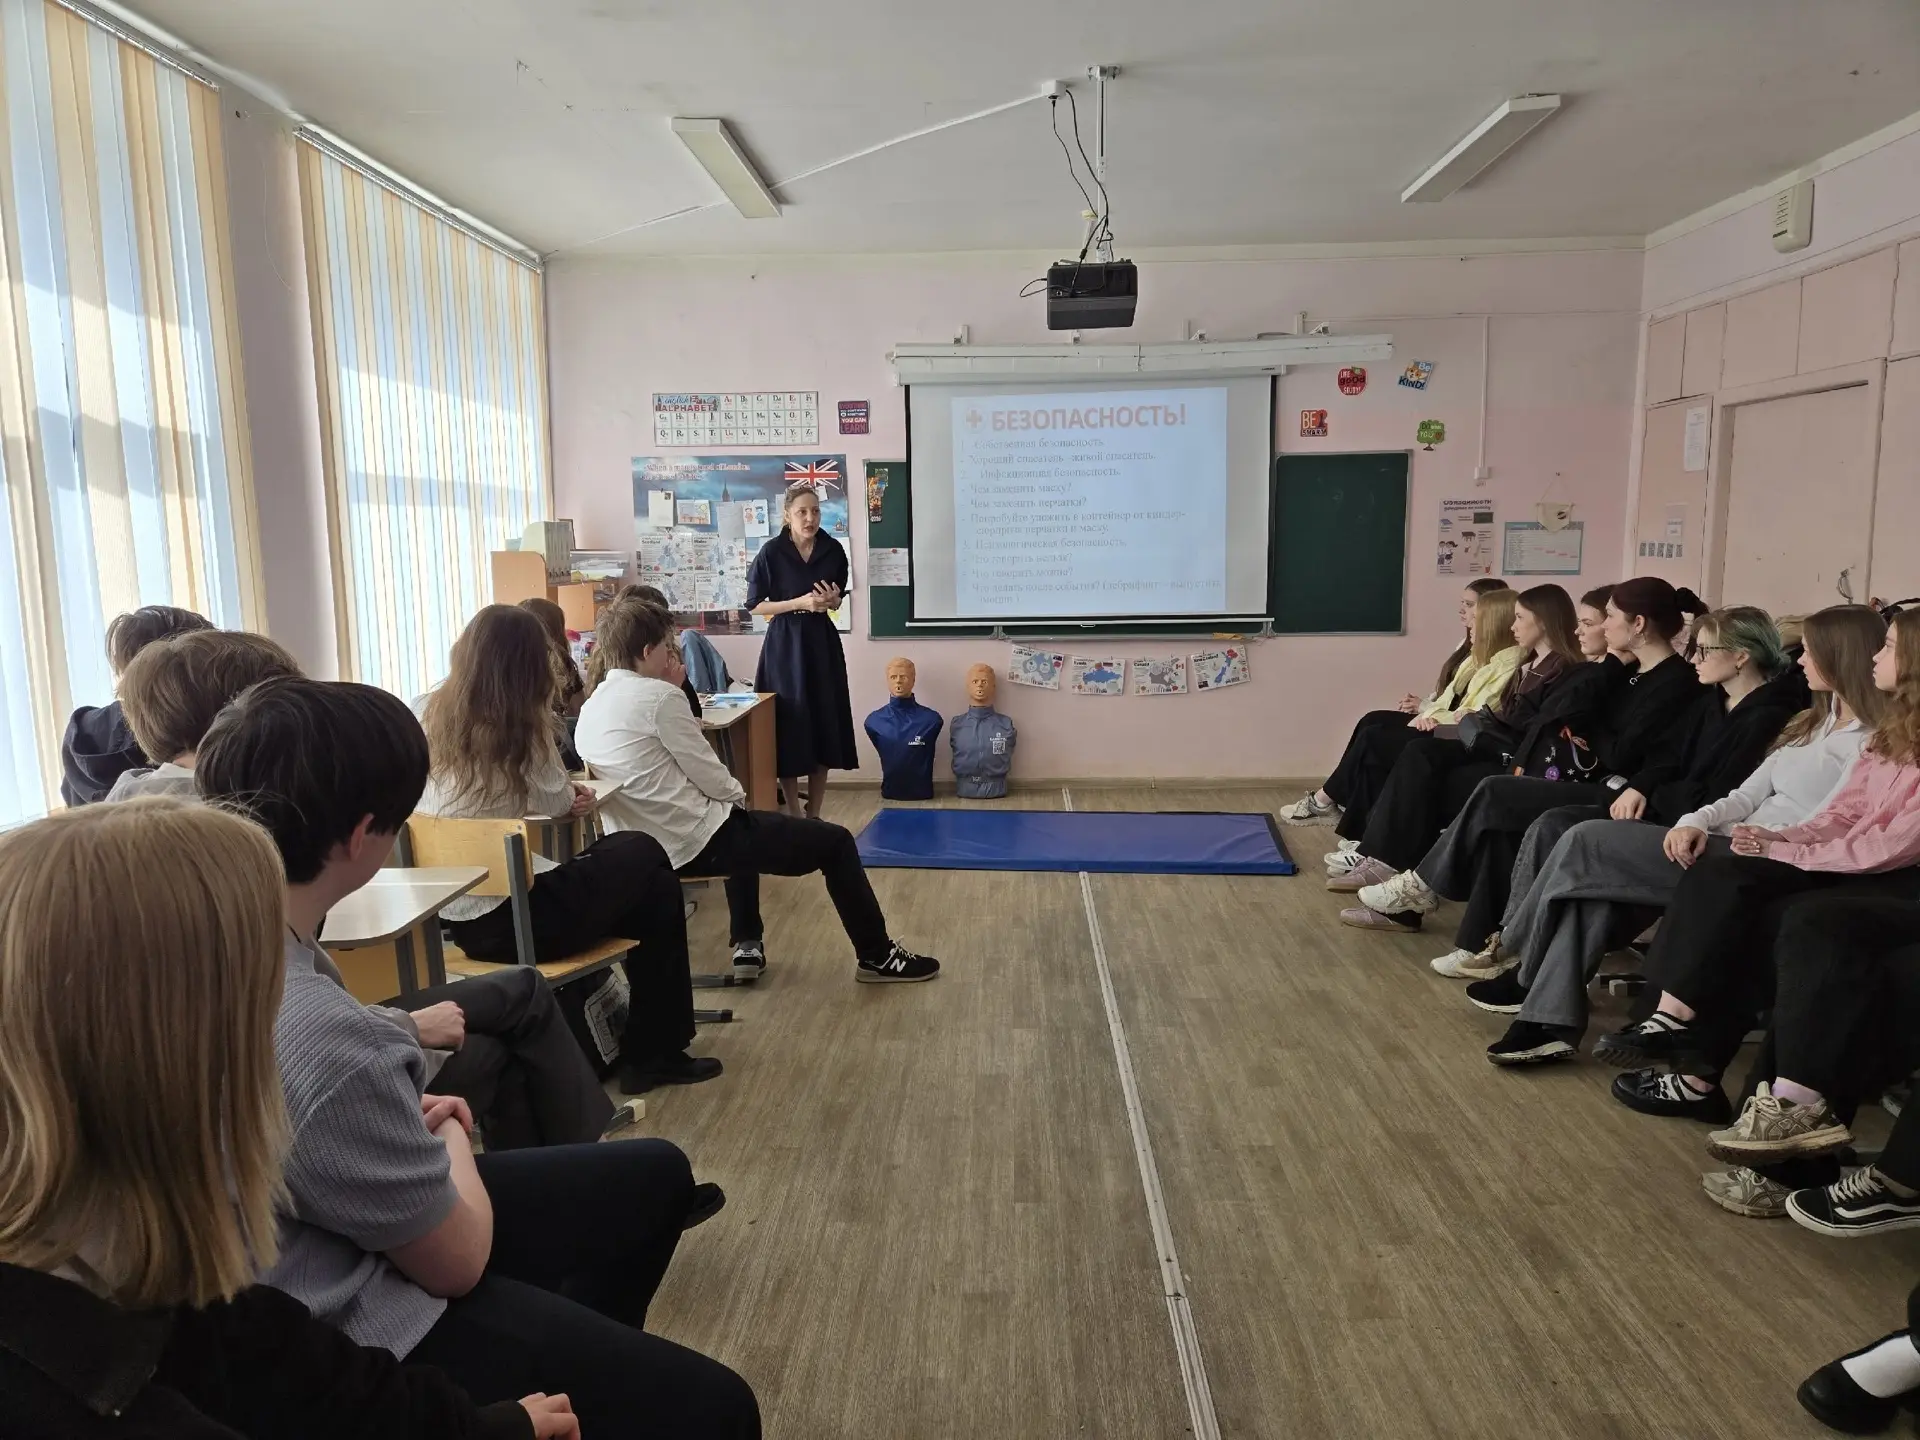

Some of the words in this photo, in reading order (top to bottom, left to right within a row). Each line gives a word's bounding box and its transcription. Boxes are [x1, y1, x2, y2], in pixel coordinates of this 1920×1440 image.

[661, 404, 713, 412] ALPHABET
[992, 402, 1187, 431] БЕЗОПАСНОСТЬ!
[1302, 411, 1317, 429] BE
[889, 958, 907, 973] N
